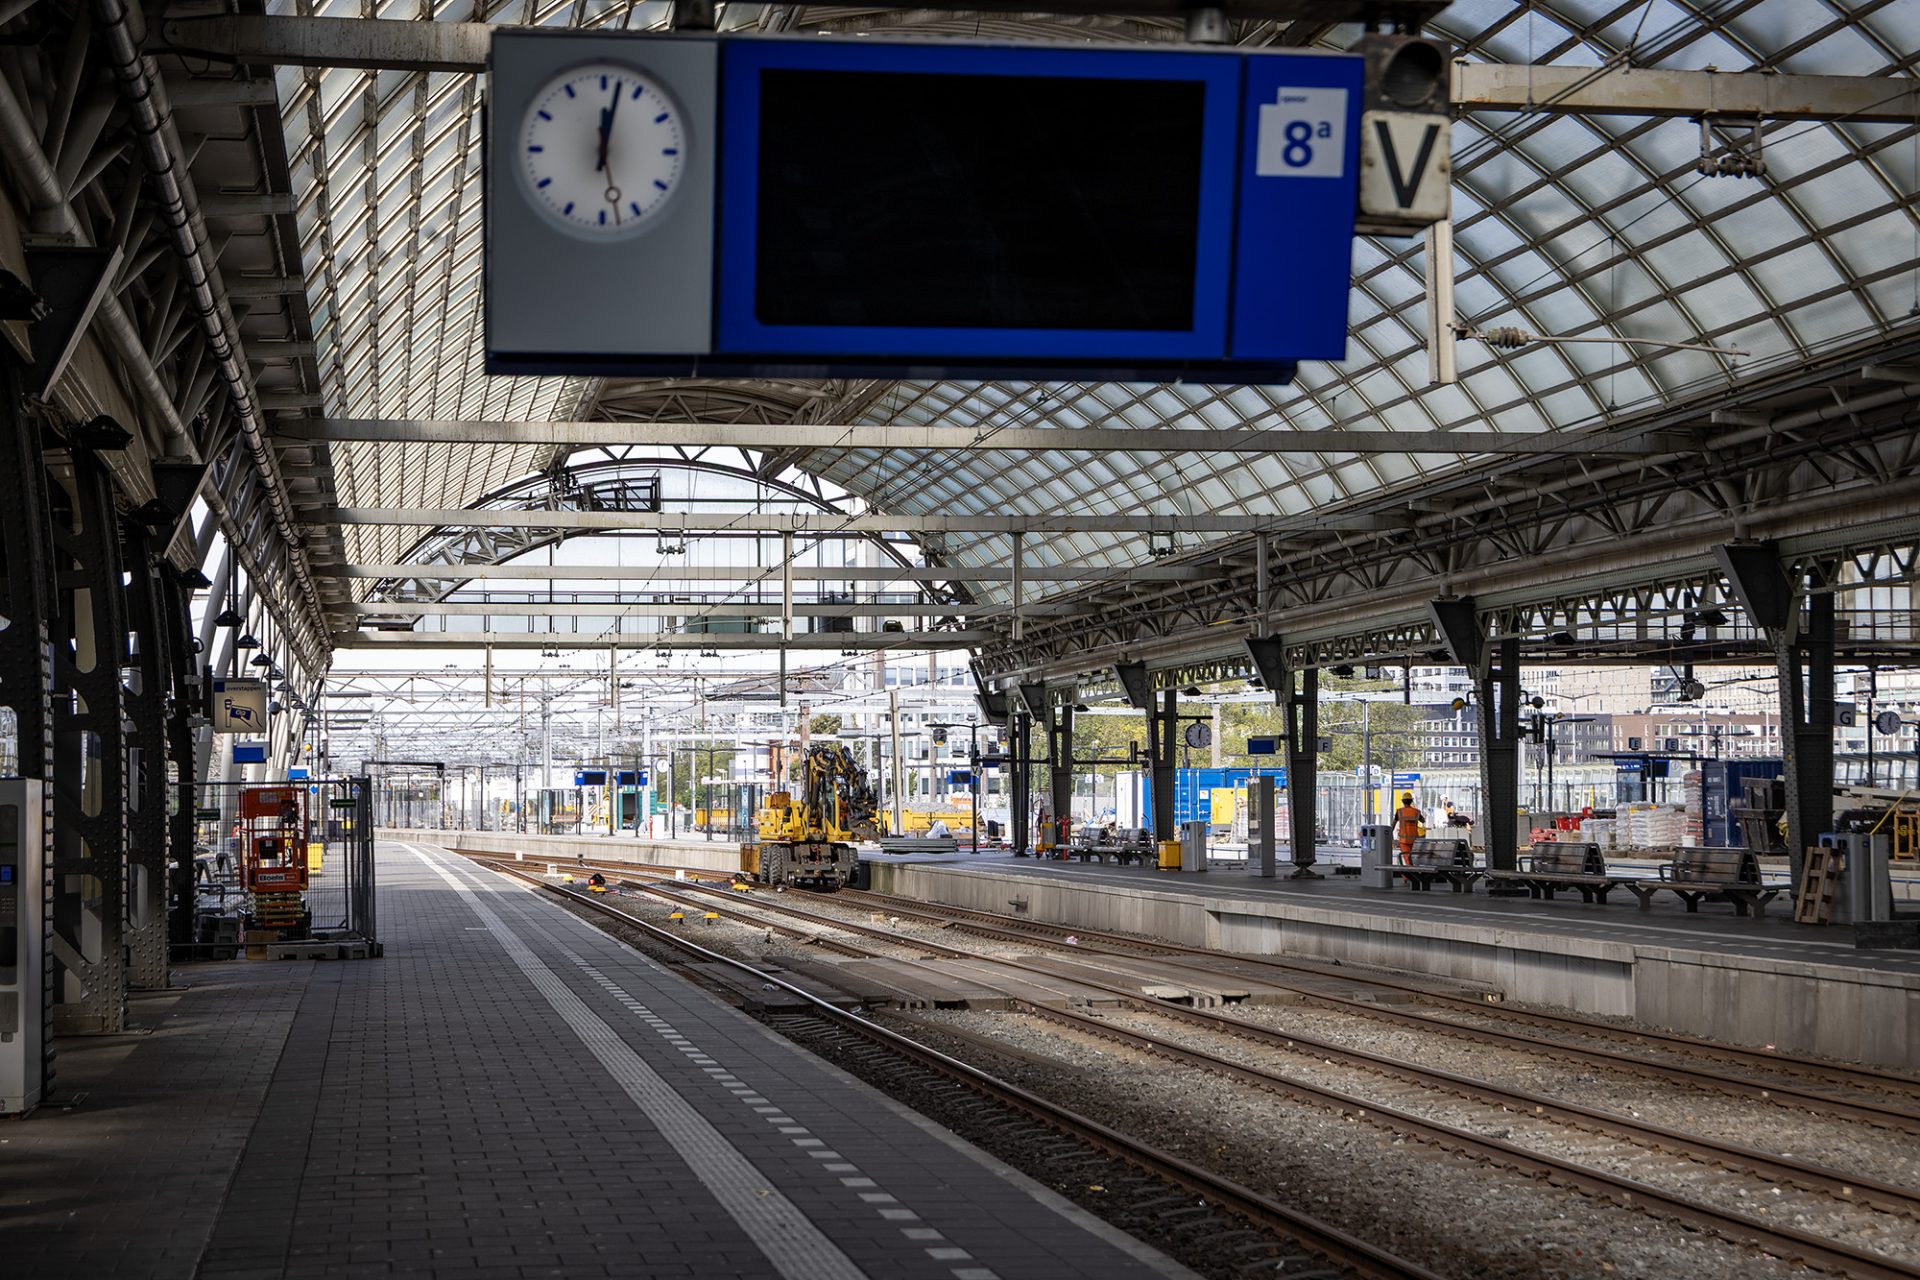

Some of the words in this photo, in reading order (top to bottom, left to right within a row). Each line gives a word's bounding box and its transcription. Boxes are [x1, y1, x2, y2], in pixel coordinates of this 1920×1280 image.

[1373, 120, 1441, 209] V
[1840, 711, 1851, 725] G
[1322, 742, 1329, 752] F
[1634, 740, 1639, 748] E
[1670, 740, 1676, 749] E
